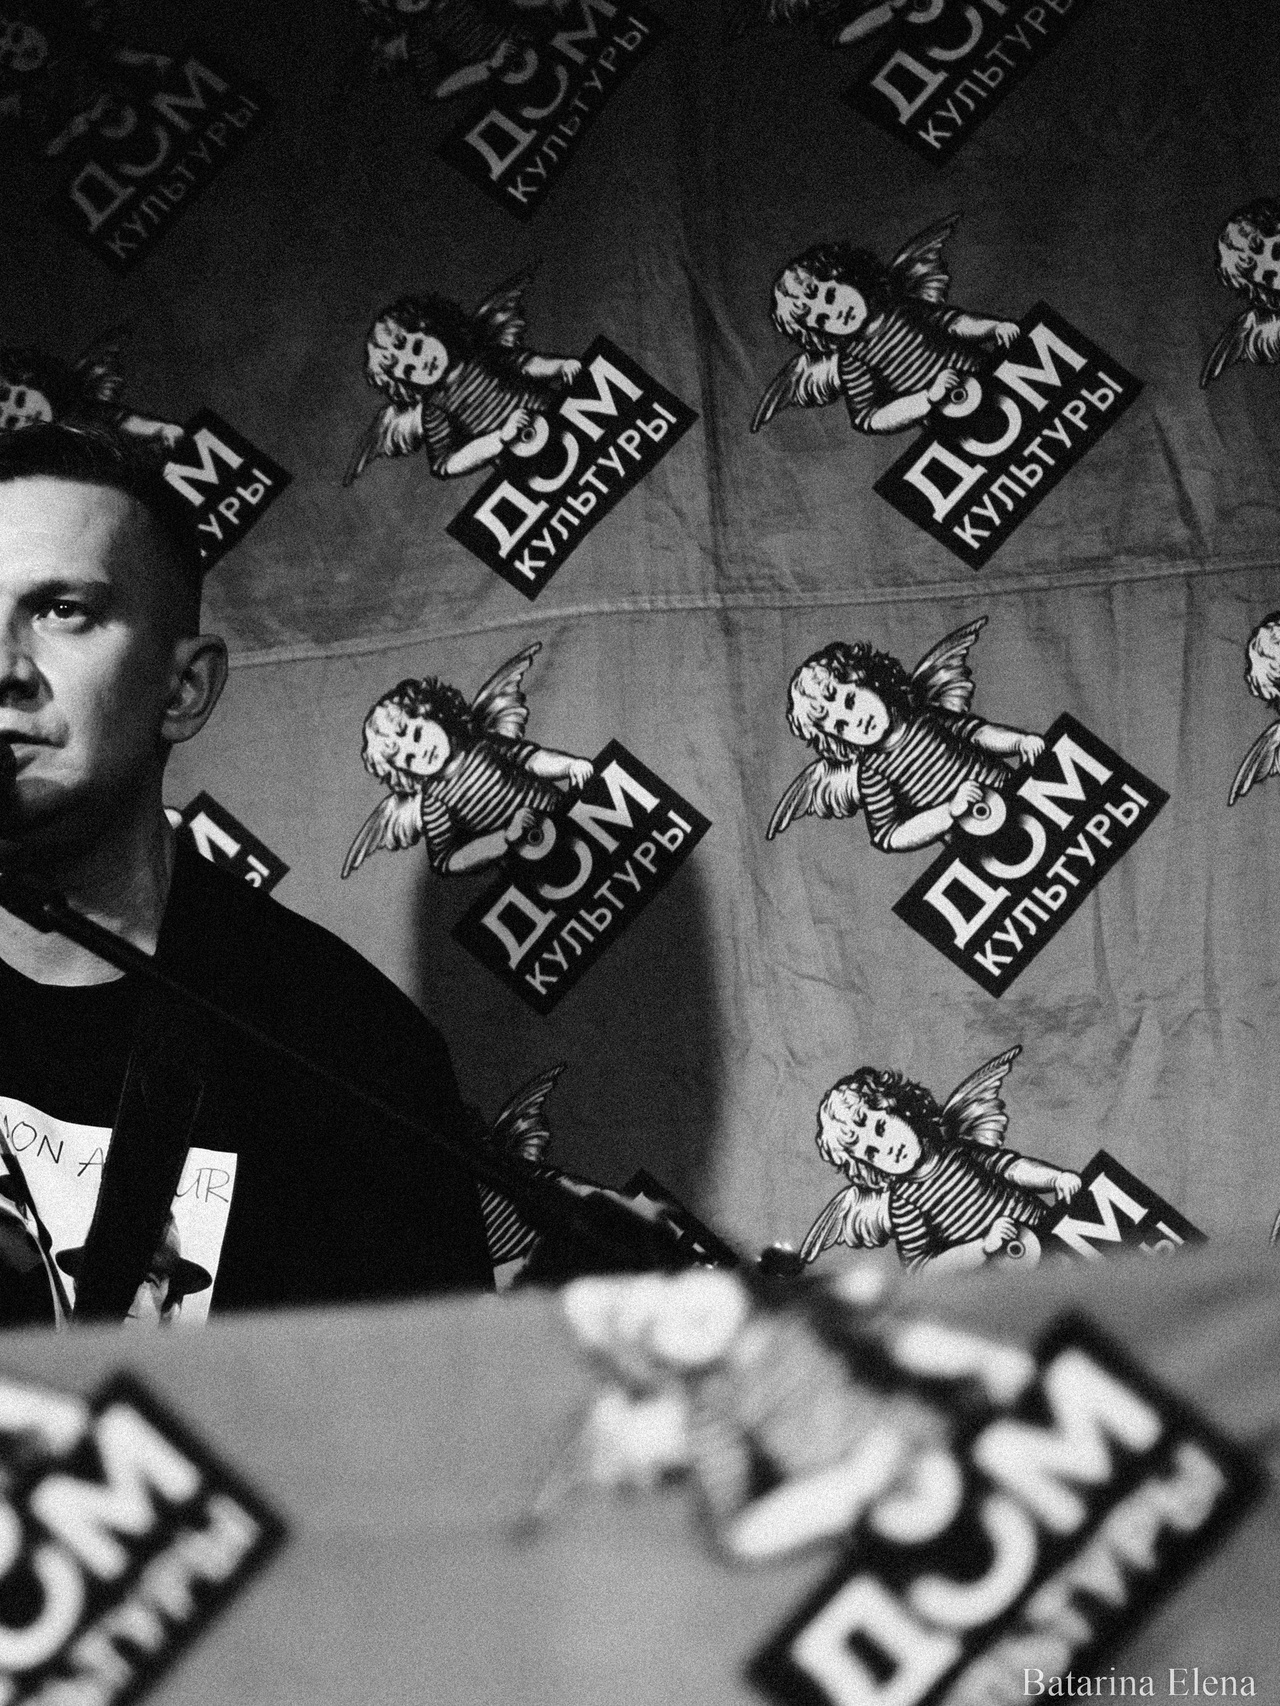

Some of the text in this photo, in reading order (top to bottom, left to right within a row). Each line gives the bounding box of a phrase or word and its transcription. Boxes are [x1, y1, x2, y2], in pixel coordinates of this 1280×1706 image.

[506, 15, 651, 203] КУЛЬТУРЫ
[870, 0, 1007, 126] ДО
[104, 94, 260, 259] КУЛЬТУРЫ
[513, 401, 678, 581] КУЛЬТУРЫ
[952, 370, 1124, 550] КУЛЬТУРЫ
[524, 810, 693, 996] КУЛЬТУРЫ
[972, 782, 1149, 977] КУЛЬТУРЫ
